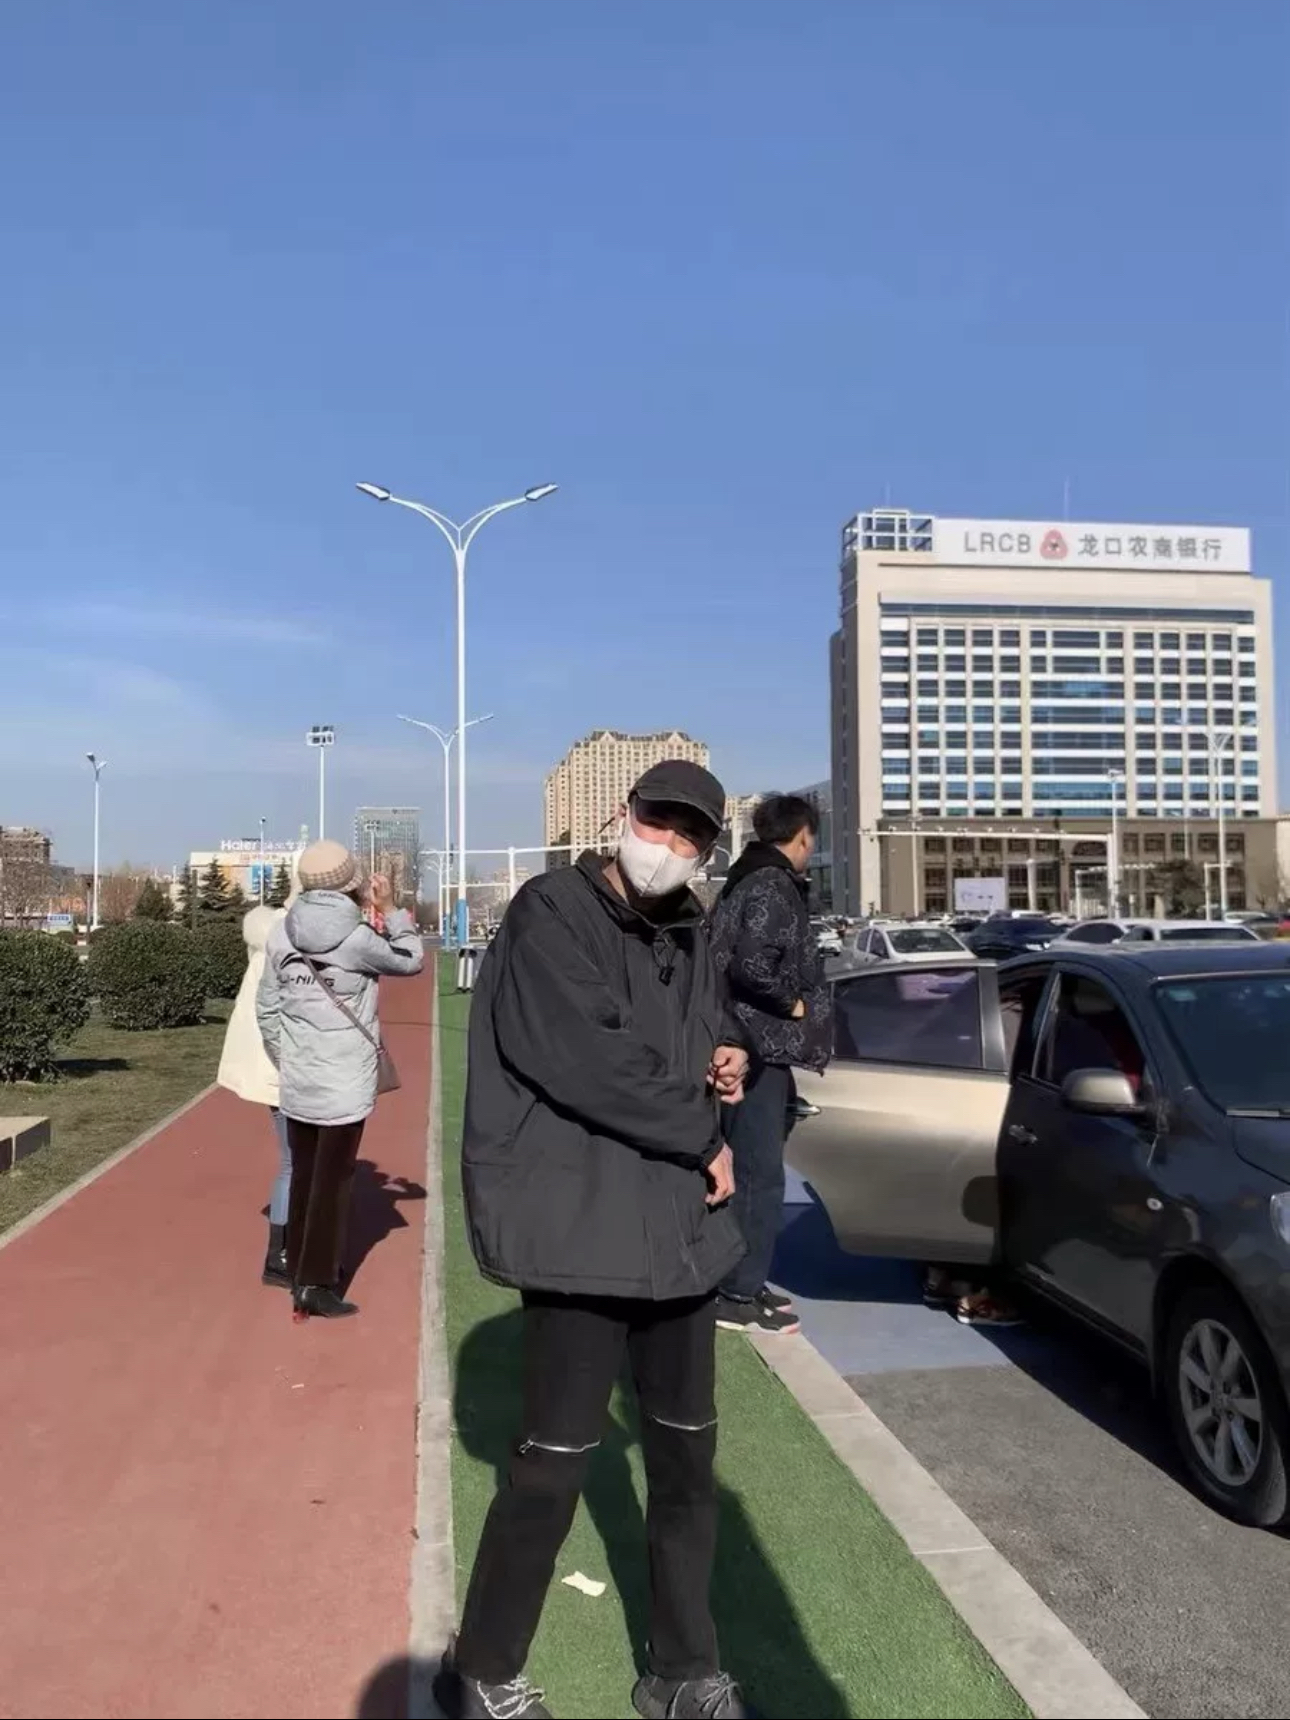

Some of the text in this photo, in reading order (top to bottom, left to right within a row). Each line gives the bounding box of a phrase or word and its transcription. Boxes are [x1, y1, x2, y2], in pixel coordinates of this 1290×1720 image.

[964, 532, 1031, 553] LRCB
[1078, 534, 1222, 560] 龙口农商银行
[221, 839, 257, 851] Haier
